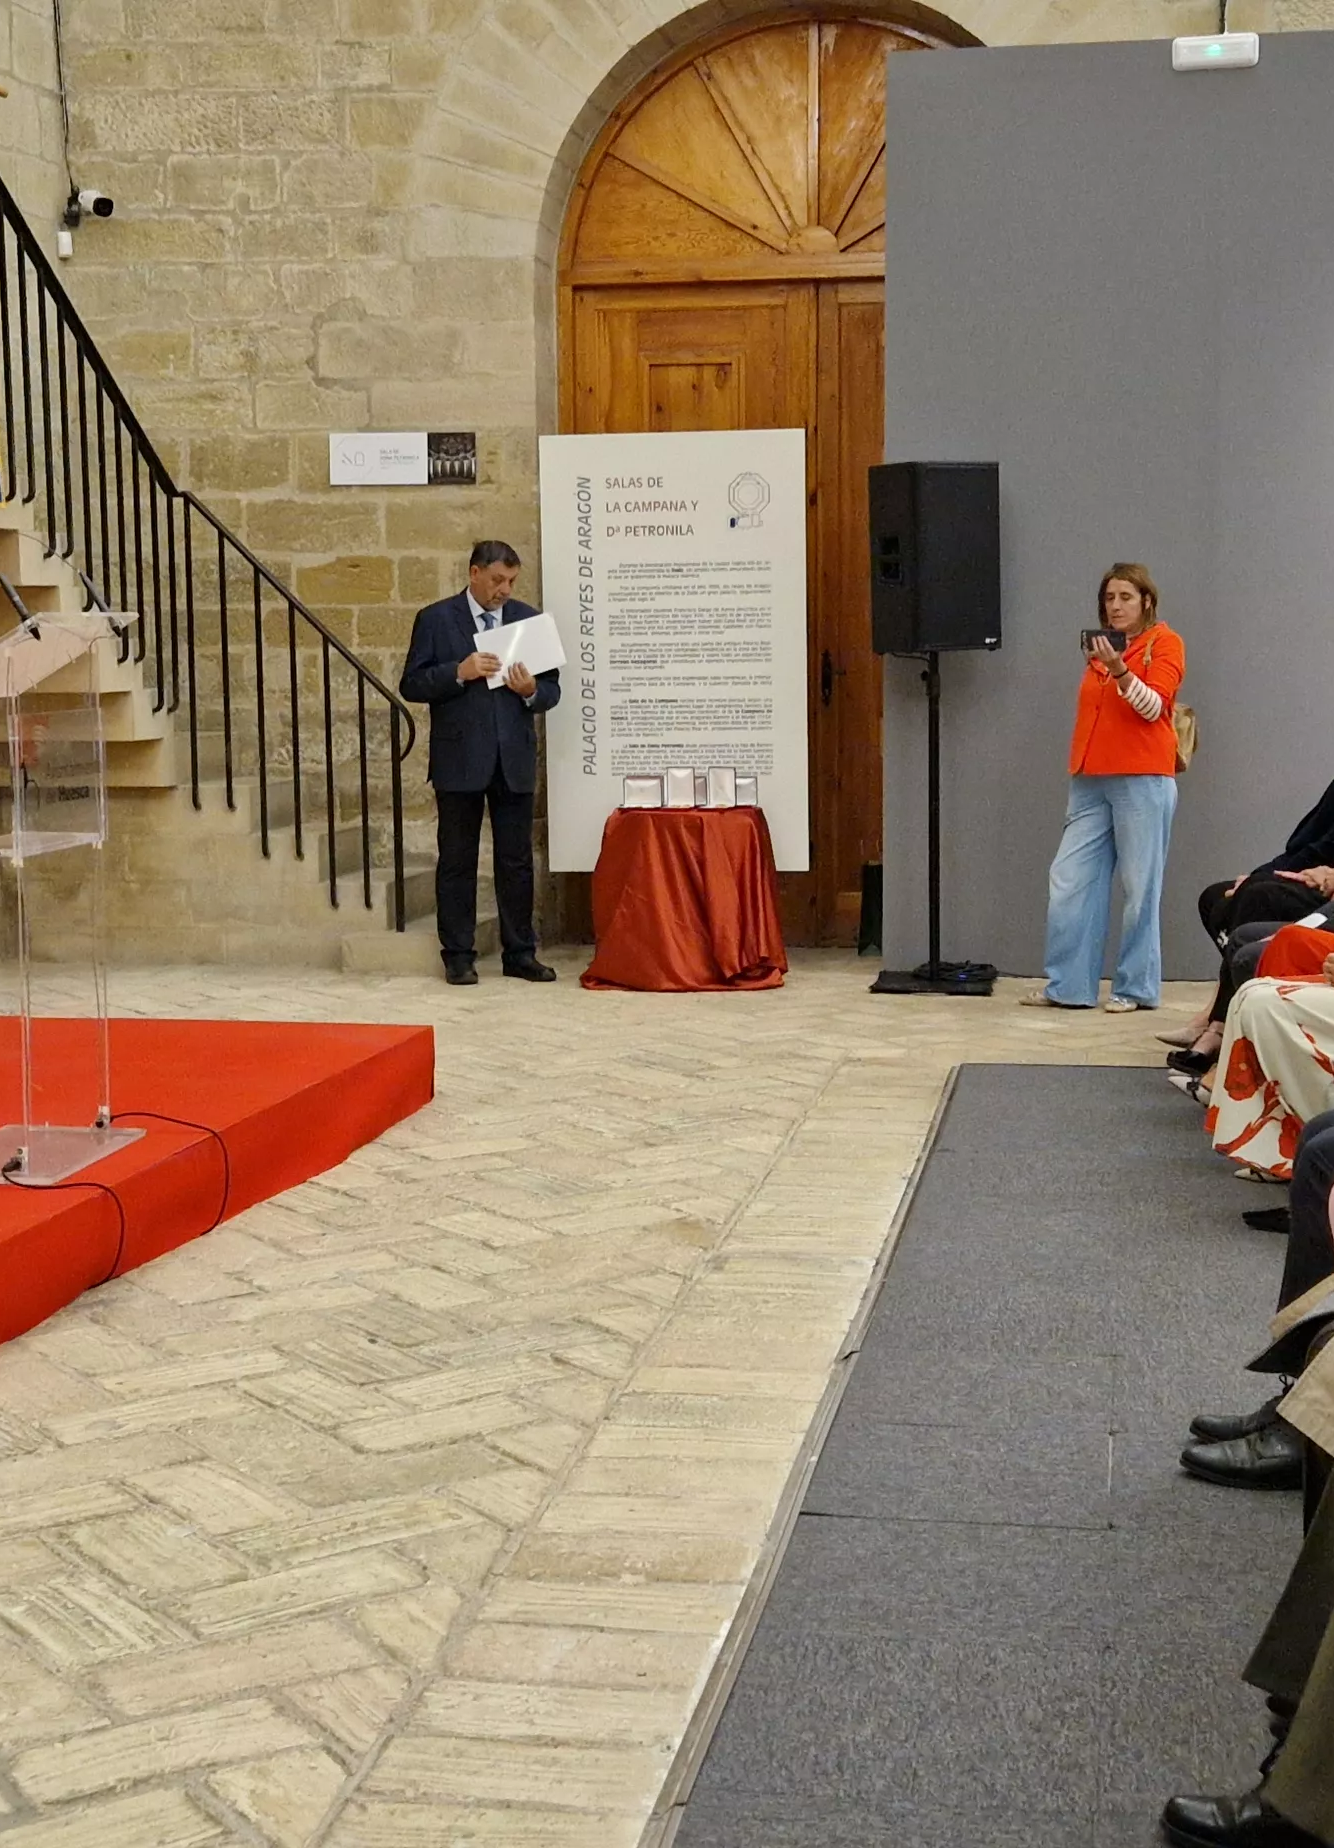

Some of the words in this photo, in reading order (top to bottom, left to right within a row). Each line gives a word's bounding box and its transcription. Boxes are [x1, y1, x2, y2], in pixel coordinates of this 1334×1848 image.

[605, 476, 643, 489] SALAS
[647, 476, 664, 488] DE
[573, 476, 593, 551] ARAGÓN
[605, 501, 621, 513] LA
[624, 500, 688, 513] CAMPANA
[691, 499, 699, 511] Y
[624, 524, 695, 537] PETRONILA
[578, 554, 594, 578] DE
[579, 582, 595, 636] REYES
[580, 641, 596, 672] LOS
[581, 677, 596, 700] DE
[581, 705, 598, 776] PALACIO
